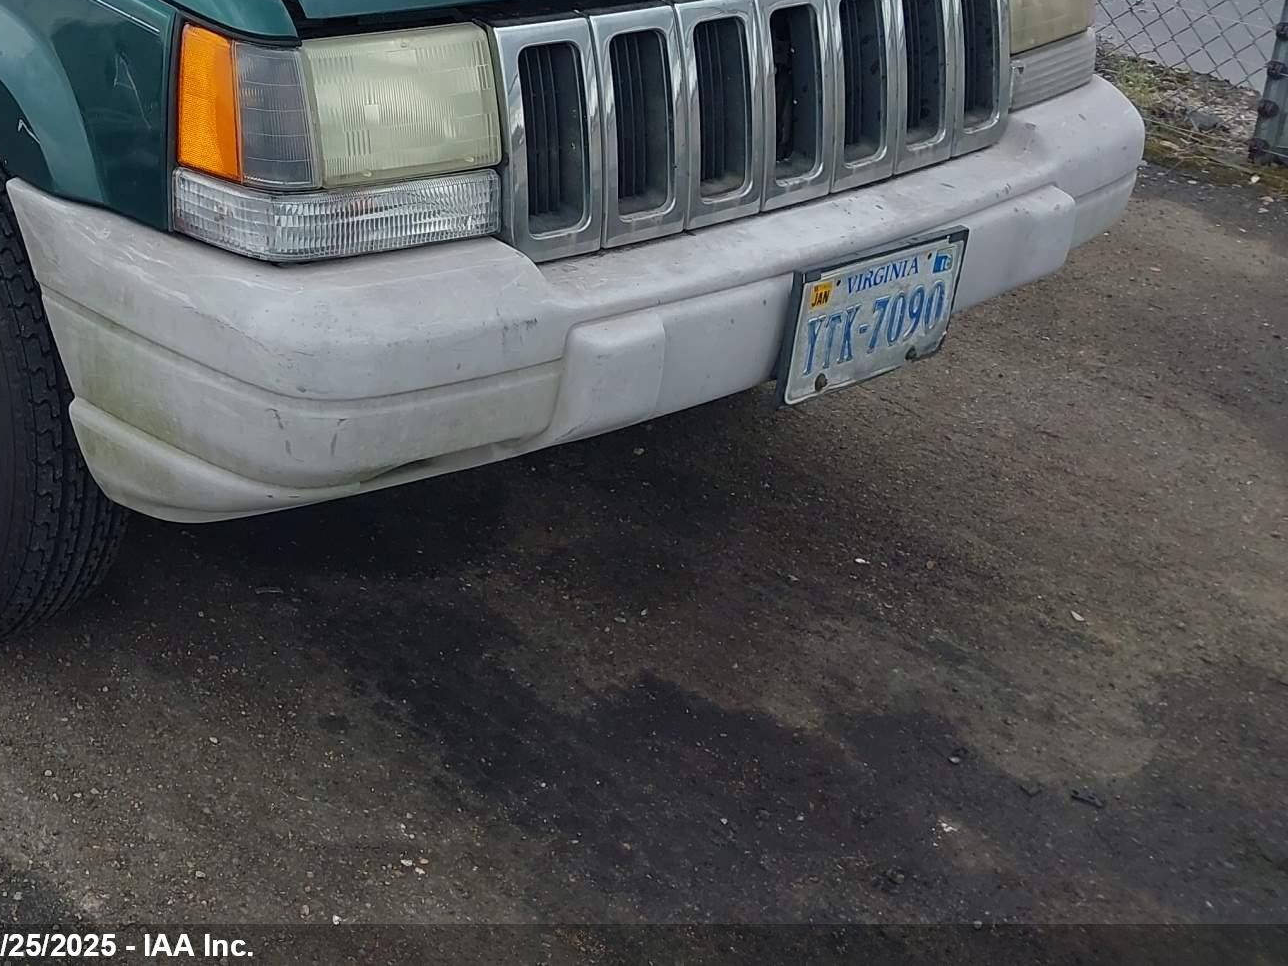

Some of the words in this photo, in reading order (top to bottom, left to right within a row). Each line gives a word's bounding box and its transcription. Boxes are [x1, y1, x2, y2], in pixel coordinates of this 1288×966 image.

[846, 257, 919, 295] VIRGINIA
[811, 289, 830, 308] JAN
[802, 281, 945, 375] YTK-7090
